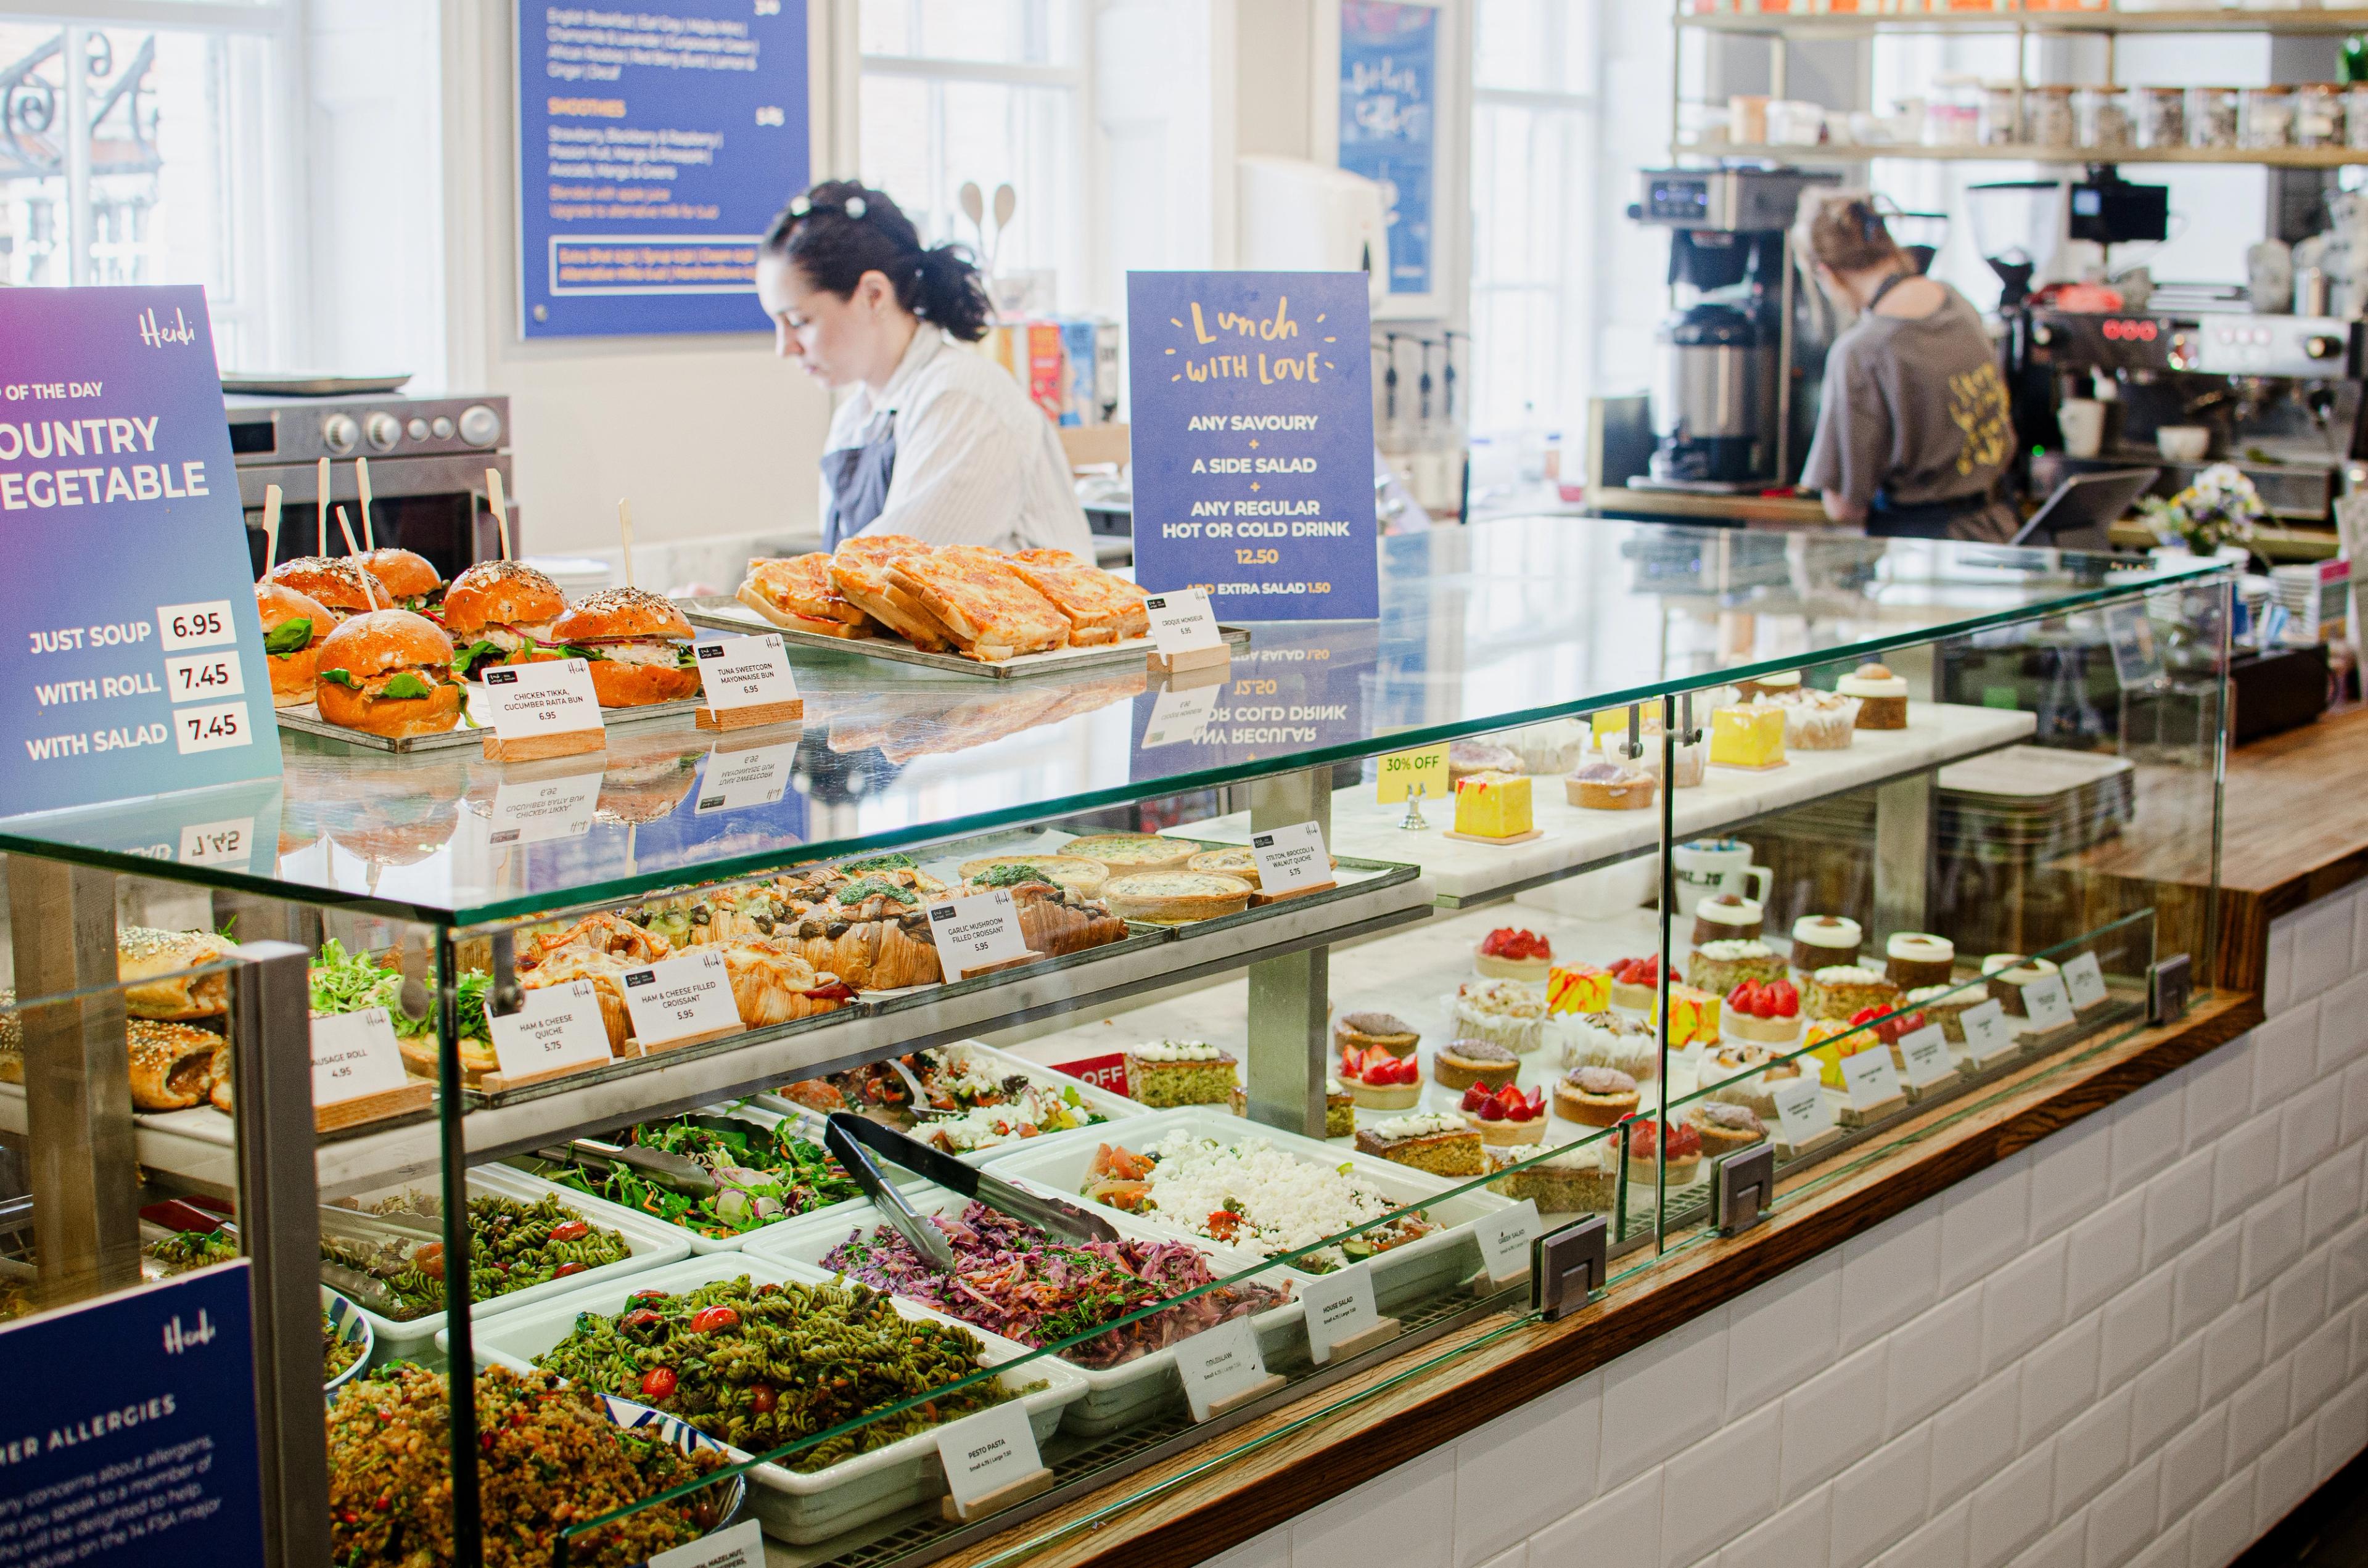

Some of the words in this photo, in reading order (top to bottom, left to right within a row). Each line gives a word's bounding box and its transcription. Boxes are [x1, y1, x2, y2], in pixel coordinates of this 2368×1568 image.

[139, 307, 195, 349] Heidi
[1190, 296, 1298, 344] Lunch
[1186, 355, 1248, 383] WITH
[1258, 352, 1320, 385] LOVE
[6, 385, 29, 401] OF
[31, 383, 66, 399] THE
[70, 381, 103, 398] DAY
[1188, 416, 1228, 432] ANY
[1231, 415, 1318, 431] SAVOURY
[1191, 459, 1206, 474] A
[1209, 458, 1252, 474] SIDE
[1255, 458, 1317, 474] SALAD
[1191, 501, 1230, 517] ANY
[1235, 500, 1320, 516] REGULAR
[1162, 523, 1202, 538] HOT
[1205, 523, 1234, 538] OR
[1236, 522, 1288, 538] COLD
[1291, 521, 1350, 537] DRINK
[1235, 549, 1279, 564] 12.50
[1217, 583, 1260, 594] EXTRA
[1262, 583, 1305, 594] SALAD
[1307, 583, 1331, 594] 1.50
[1162, 618, 1180, 626] CROQUE
[29, 628, 84, 654] JUST
[90, 622, 151, 647] SOUP
[173, 612, 222, 638] 6.95
[718, 667, 734, 675] TUNA
[736, 663, 773, 673] SWEETCORN
[35, 679, 97, 705] WITH
[102, 673, 162, 698] ROLL
[179, 663, 229, 689] 7.45
[721, 673, 760, 684] MAYONNAISE
[514, 691, 545, 700] CHICKEN
[547, 689, 570, 697] TIKKA,
[744, 685, 758, 694] 6.95
[504, 701, 545, 710] CUCUMBER
[539, 711, 556, 720] 6.95
[26, 734, 89, 761] WITH
[93, 723, 168, 752] SALAD
[188, 714, 237, 741] 7.45
[1387, 757, 1411, 771] 30%
[1415, 755, 1439, 769] OFF
[1265, 853, 1286, 861] STILTON,
[1286, 847, 1310, 857] BROCCOLI
[1272, 859, 1293, 868] WALNUT
[1294, 855, 1312, 864] QUICHE
[948, 924, 969, 935] GARLIC
[970, 917, 1003, 930] MUSHROOM
[952, 934, 972, 943] FILLED
[972, 926, 1004, 938] CROISSANT
[975, 942, 989, 951] 5.95
[641, 994, 658, 1003] HAM
[665, 987, 691, 998] CHEESE
[693, 982, 716, 992] FILLED
[662, 995, 701, 1009] CROISSANT
[677, 1009, 694, 1020] 5.95
[520, 1022, 537, 1032] HAM
[545, 1014, 573, 1026] CHEESE
[535, 1027, 564, 1039] QUICHE
[545, 1041, 562, 1051] 5.75
[311, 1054, 345, 1066] AUSAGE
[347, 1049, 368, 1059] ROLL
[332, 1067, 352, 1077] 4.95
[1080, 1065, 1123, 1086] OFF
[1323, 1302, 1338, 1313] HOUSE
[1339, 1296, 1353, 1307] SALAD
[1206, 1352, 1232, 1366] COLESLAW
[47, 1393, 176, 1452] ALLERGIES
[968, 1447, 987, 1459] PESTO
[987, 1439, 1006, 1451] PASTA
[969, 1463, 980, 1472] Small
[992, 1455, 1003, 1463] Large
